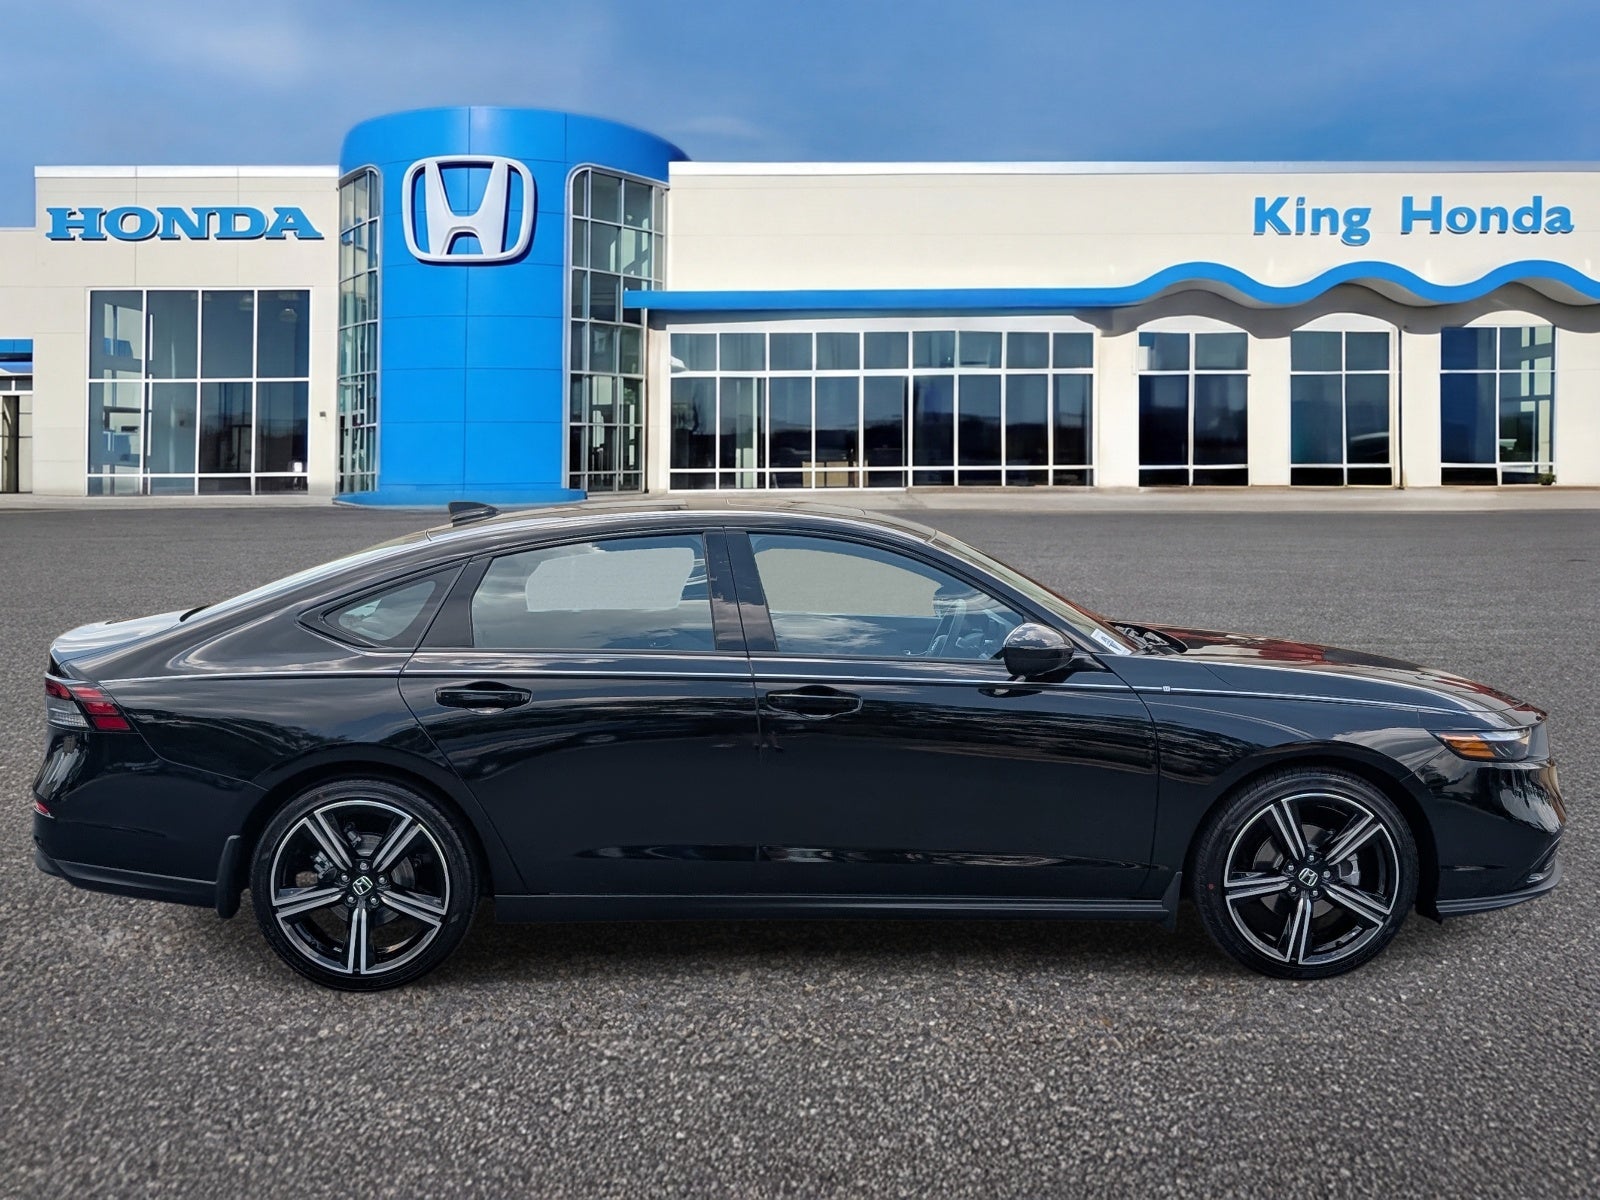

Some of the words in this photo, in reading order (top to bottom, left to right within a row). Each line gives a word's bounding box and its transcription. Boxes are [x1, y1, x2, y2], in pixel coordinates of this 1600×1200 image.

[46, 206, 324, 241] HONDA
[1253, 196, 1372, 246] King
[1400, 195, 1574, 234] Honda
